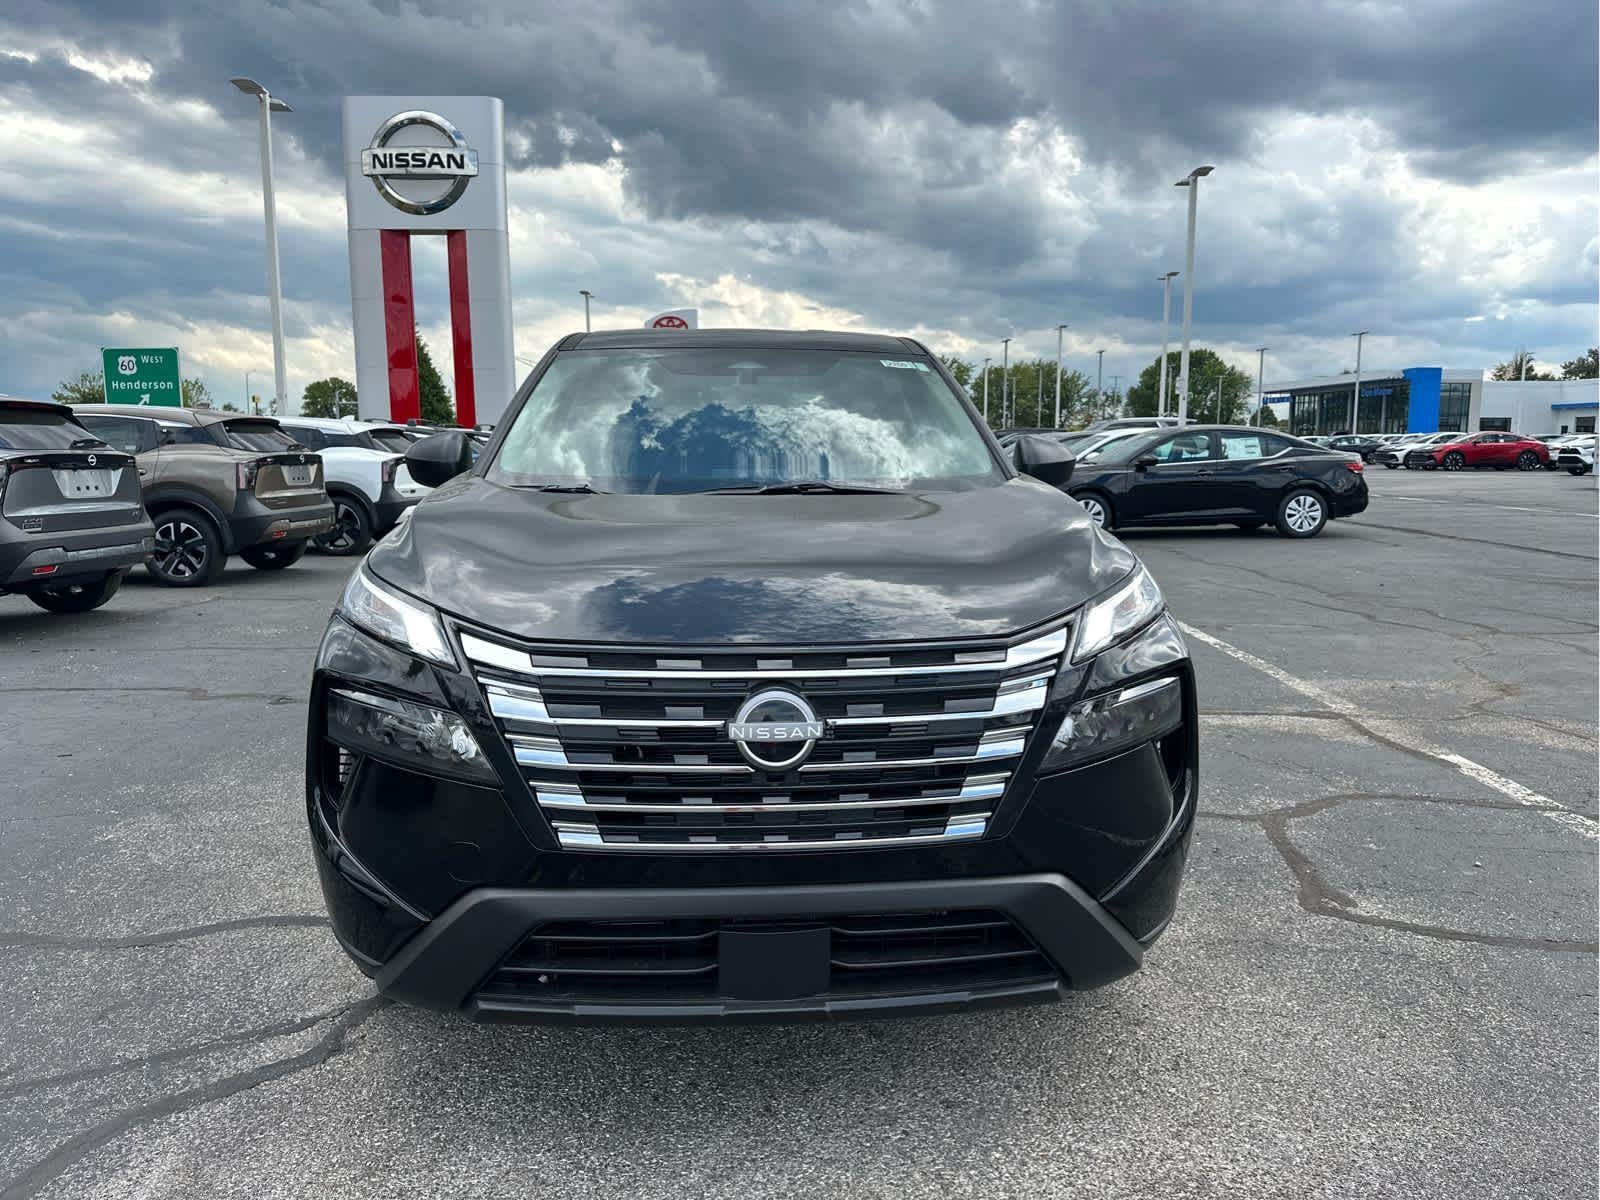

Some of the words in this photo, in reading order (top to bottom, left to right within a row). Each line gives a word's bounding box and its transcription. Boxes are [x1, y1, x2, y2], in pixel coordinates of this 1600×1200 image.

[372, 153, 465, 169] NISSAN
[120, 359, 135, 371] 60
[140, 355, 164, 364] WEST
[111, 380, 174, 390] Henderson
[731, 725, 821, 739] NISSAN
